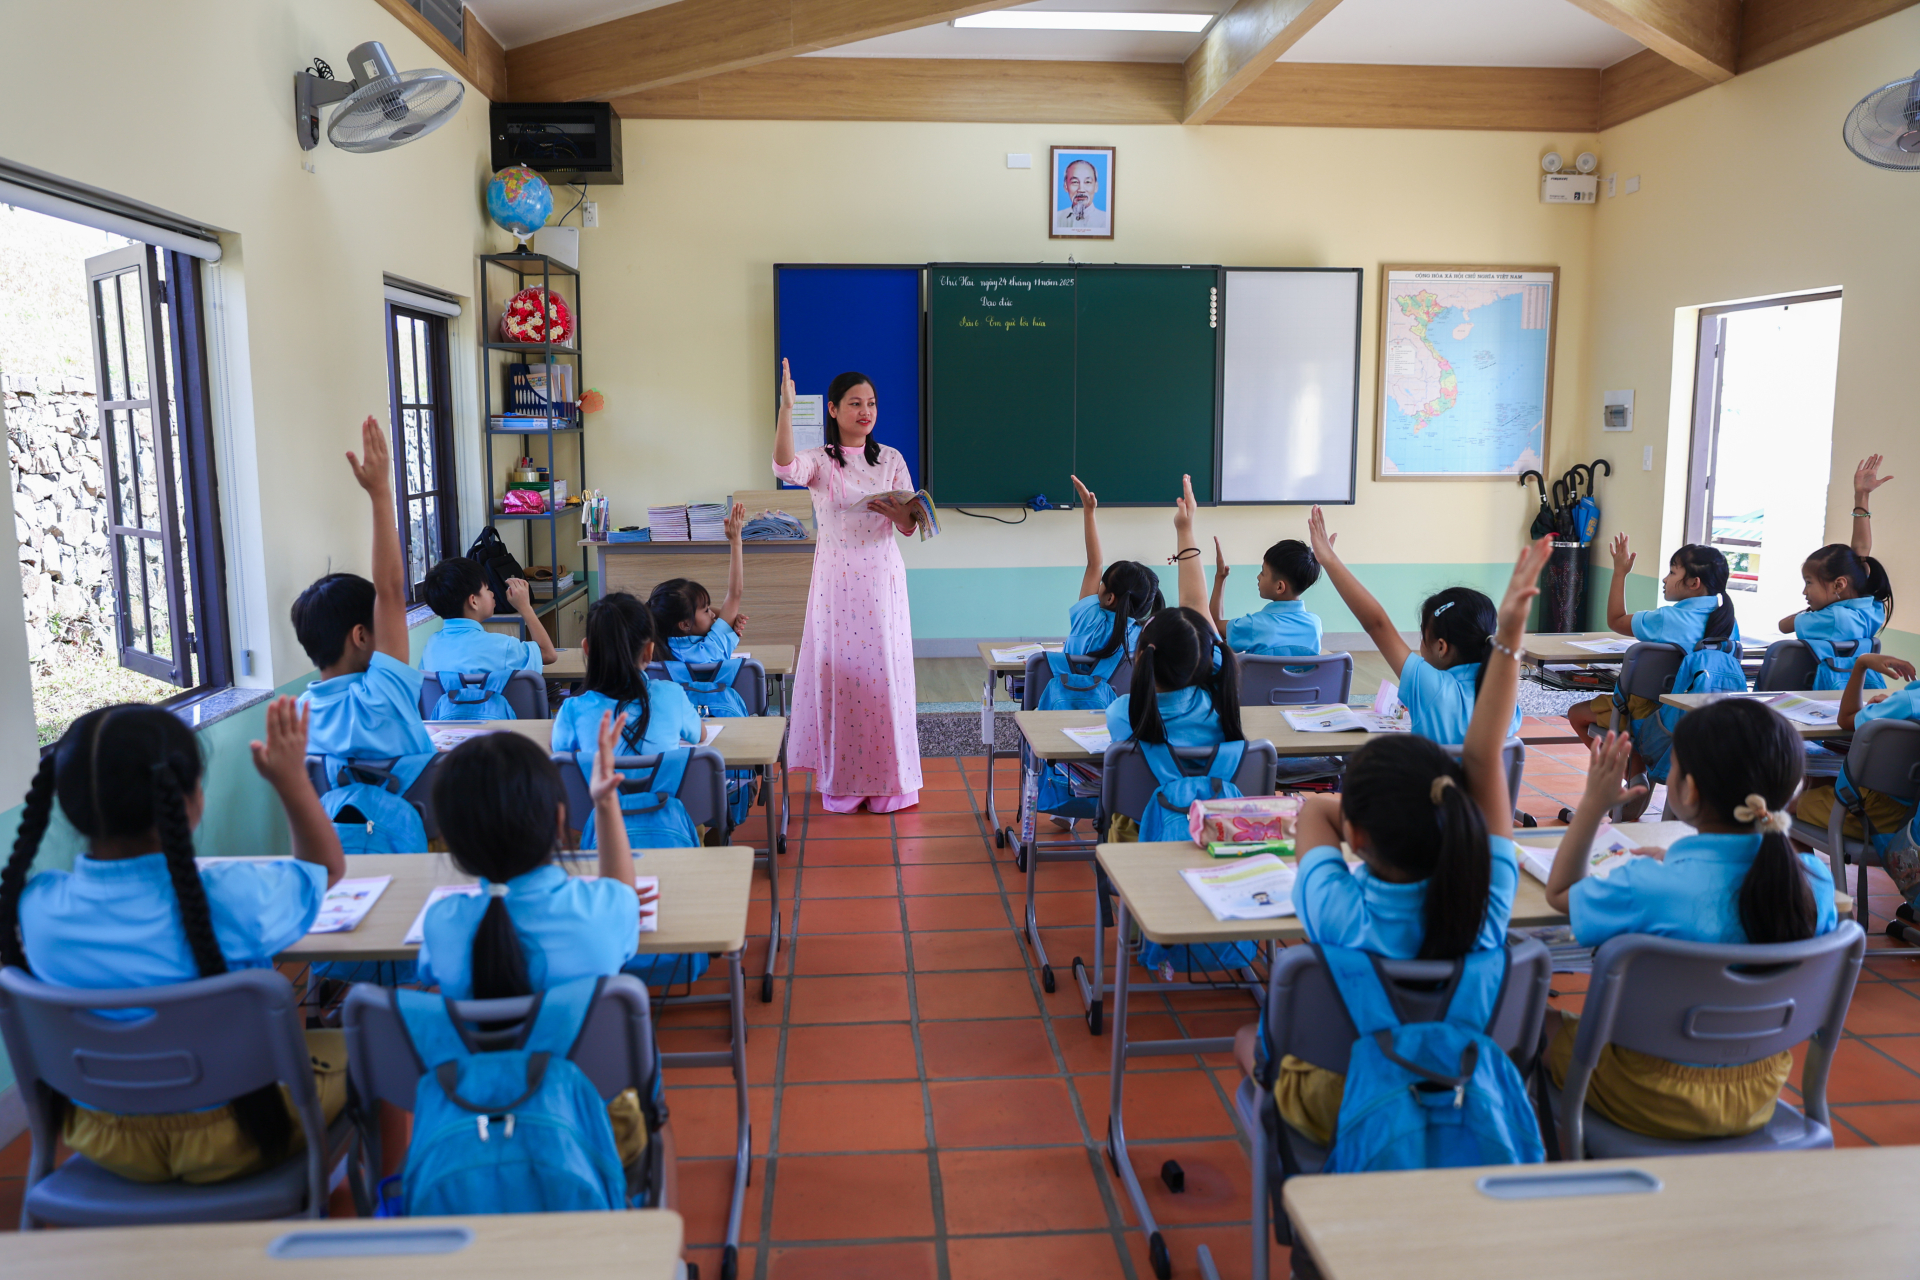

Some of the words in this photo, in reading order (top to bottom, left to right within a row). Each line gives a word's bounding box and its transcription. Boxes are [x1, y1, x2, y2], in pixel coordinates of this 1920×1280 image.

[1453, 272, 1464, 280] HỘI
[939, 275, 958, 287] Thứ
[959, 275, 975, 287] Hai
[980, 278, 997, 292] ngày
[998, 277, 1007, 286] 24
[1009, 275, 1031, 291] tháng
[1034, 278, 1041, 286] 11
[1041, 278, 1059, 287] năm
[1059, 278, 1075, 287] 2025
[998, 296, 1014, 307] đức
[985, 315, 1002, 327] Em
[1032, 316, 1047, 327] hứa
